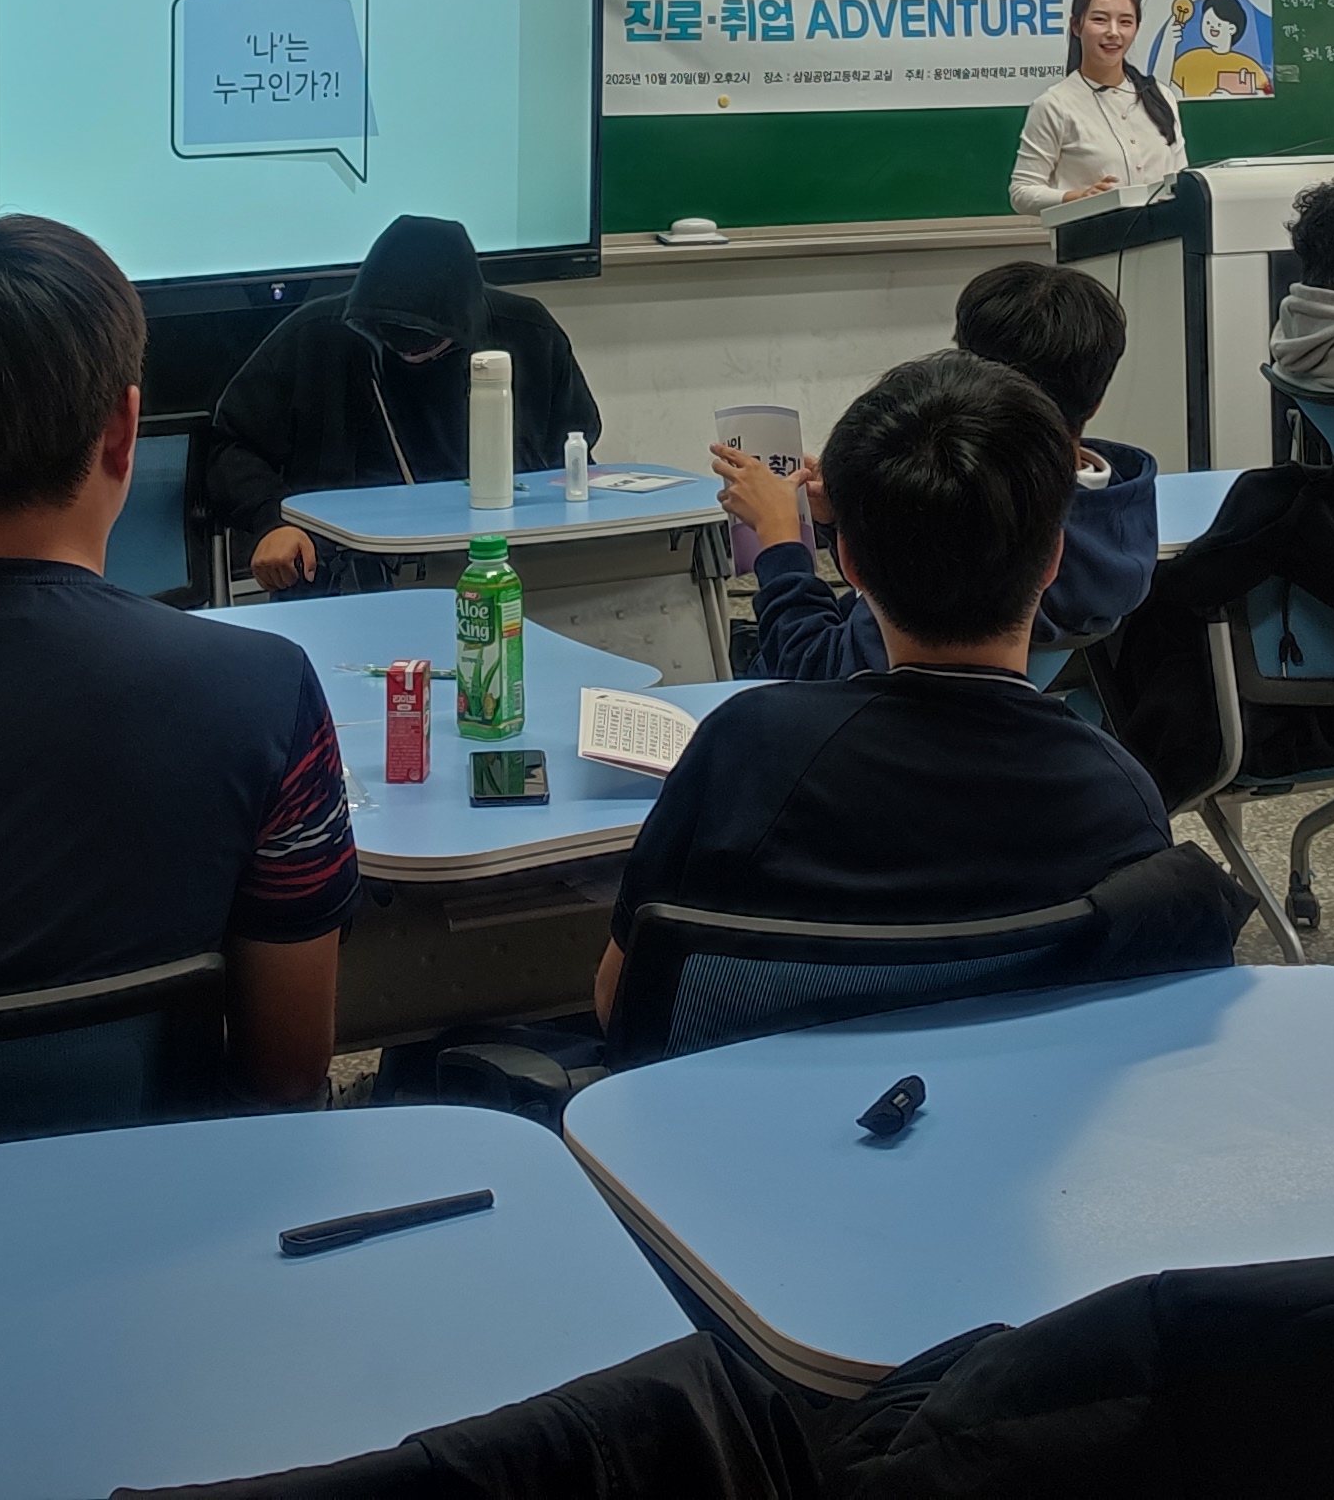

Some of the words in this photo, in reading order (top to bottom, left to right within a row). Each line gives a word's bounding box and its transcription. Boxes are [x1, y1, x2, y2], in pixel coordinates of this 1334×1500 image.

[246, 31, 309, 64] '나'는
[213, 69, 340, 105] 누구인가?!
[605, 73, 641, 86] 2025년
[644, 72, 667, 86] 10월
[669, 72, 711, 86] 20일(월)
[712, 71, 751, 85] 오후2시
[763, 71, 783, 84] 장소
[792, 70, 871, 84] 삼일공업고등학교
[872, 69, 893, 82] 교실
[904, 69, 925, 82] 주최
[933, 66, 1017, 81] 용인예술과학대학교
[1019, 65, 1067, 79] 대학일자리
[768, 453, 801, 477] 찾기
[456, 598, 490, 620] Aloe
[456, 617, 490, 642] King
